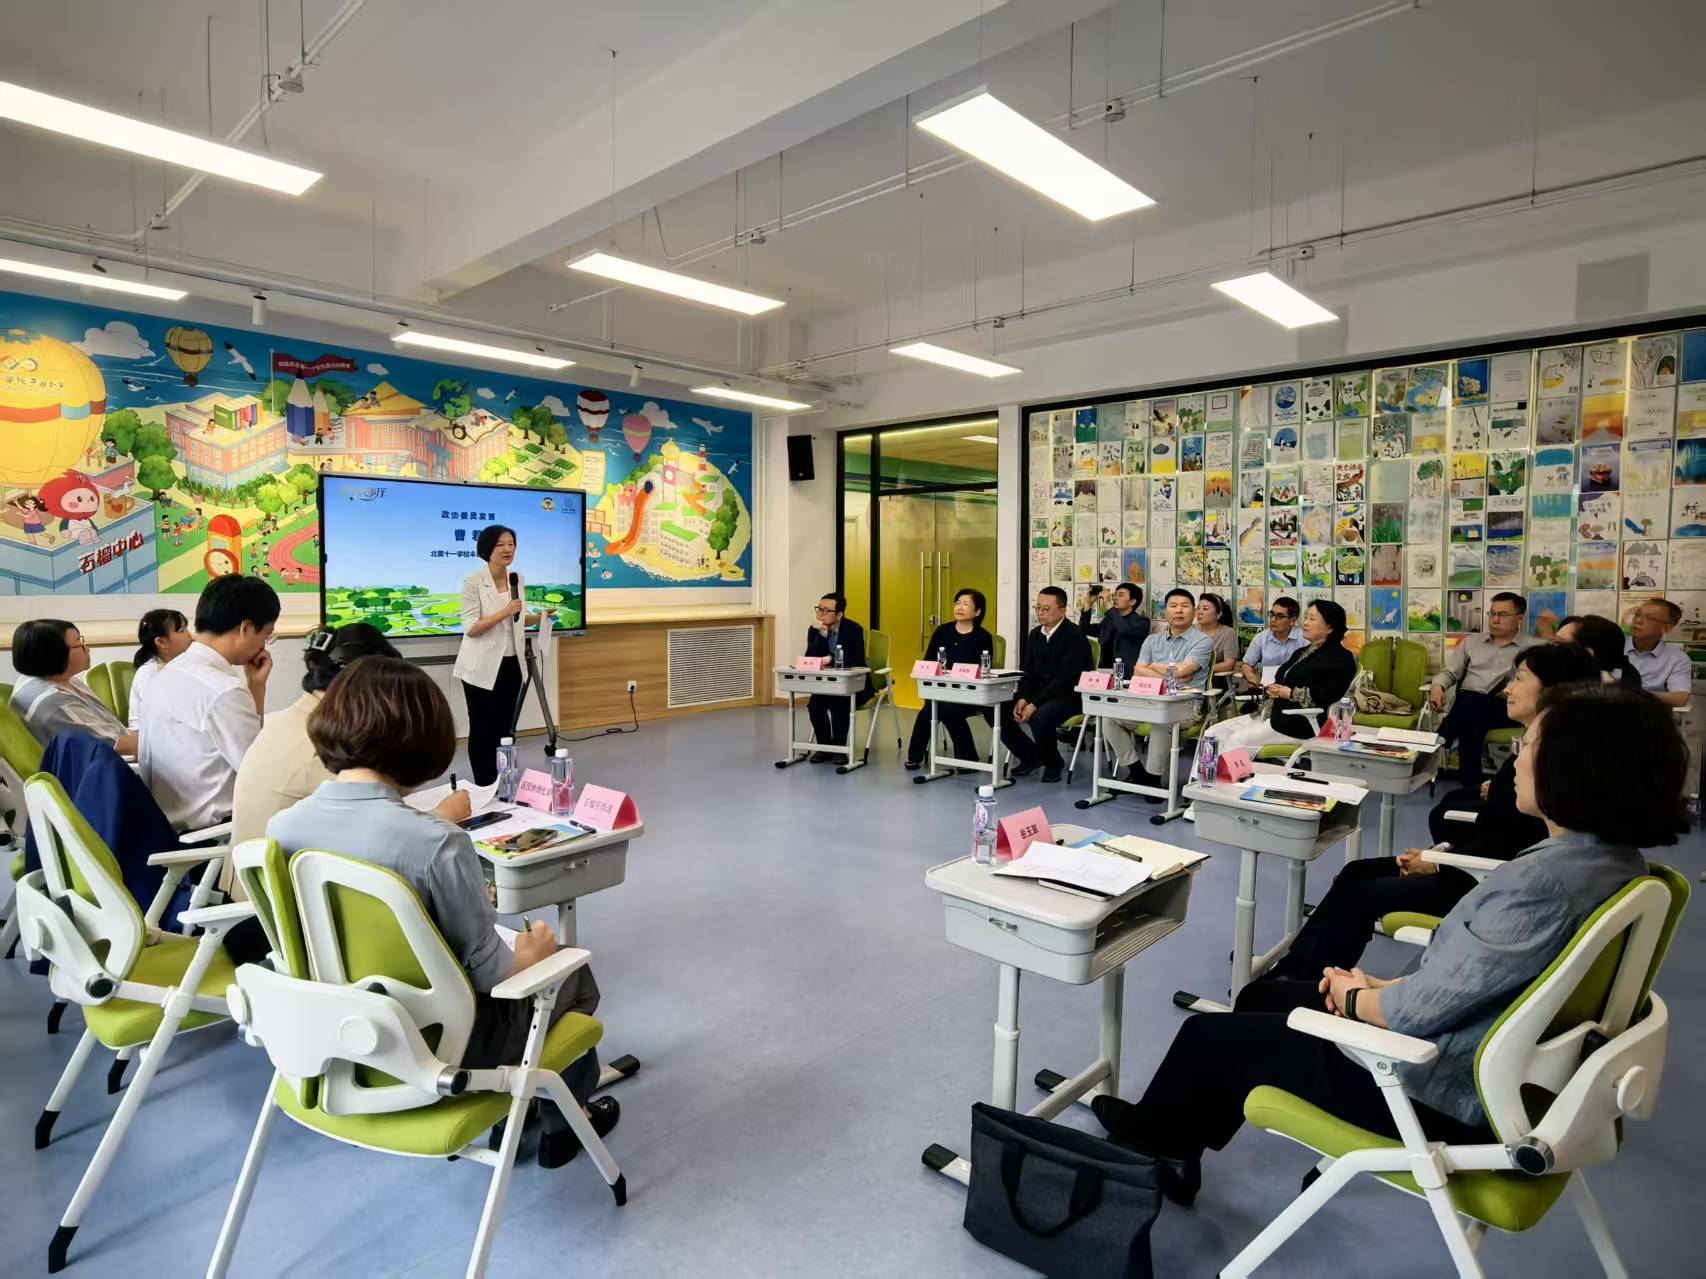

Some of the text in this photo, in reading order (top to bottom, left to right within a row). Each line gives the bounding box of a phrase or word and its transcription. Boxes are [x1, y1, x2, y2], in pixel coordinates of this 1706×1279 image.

[0, 376, 65, 388] 学校丰台小学
[441, 510, 495, 520] 政协委员发言
[79, 531, 144, 574] 石榴中心
[430, 550, 479, 558] 北京十一学校丰
